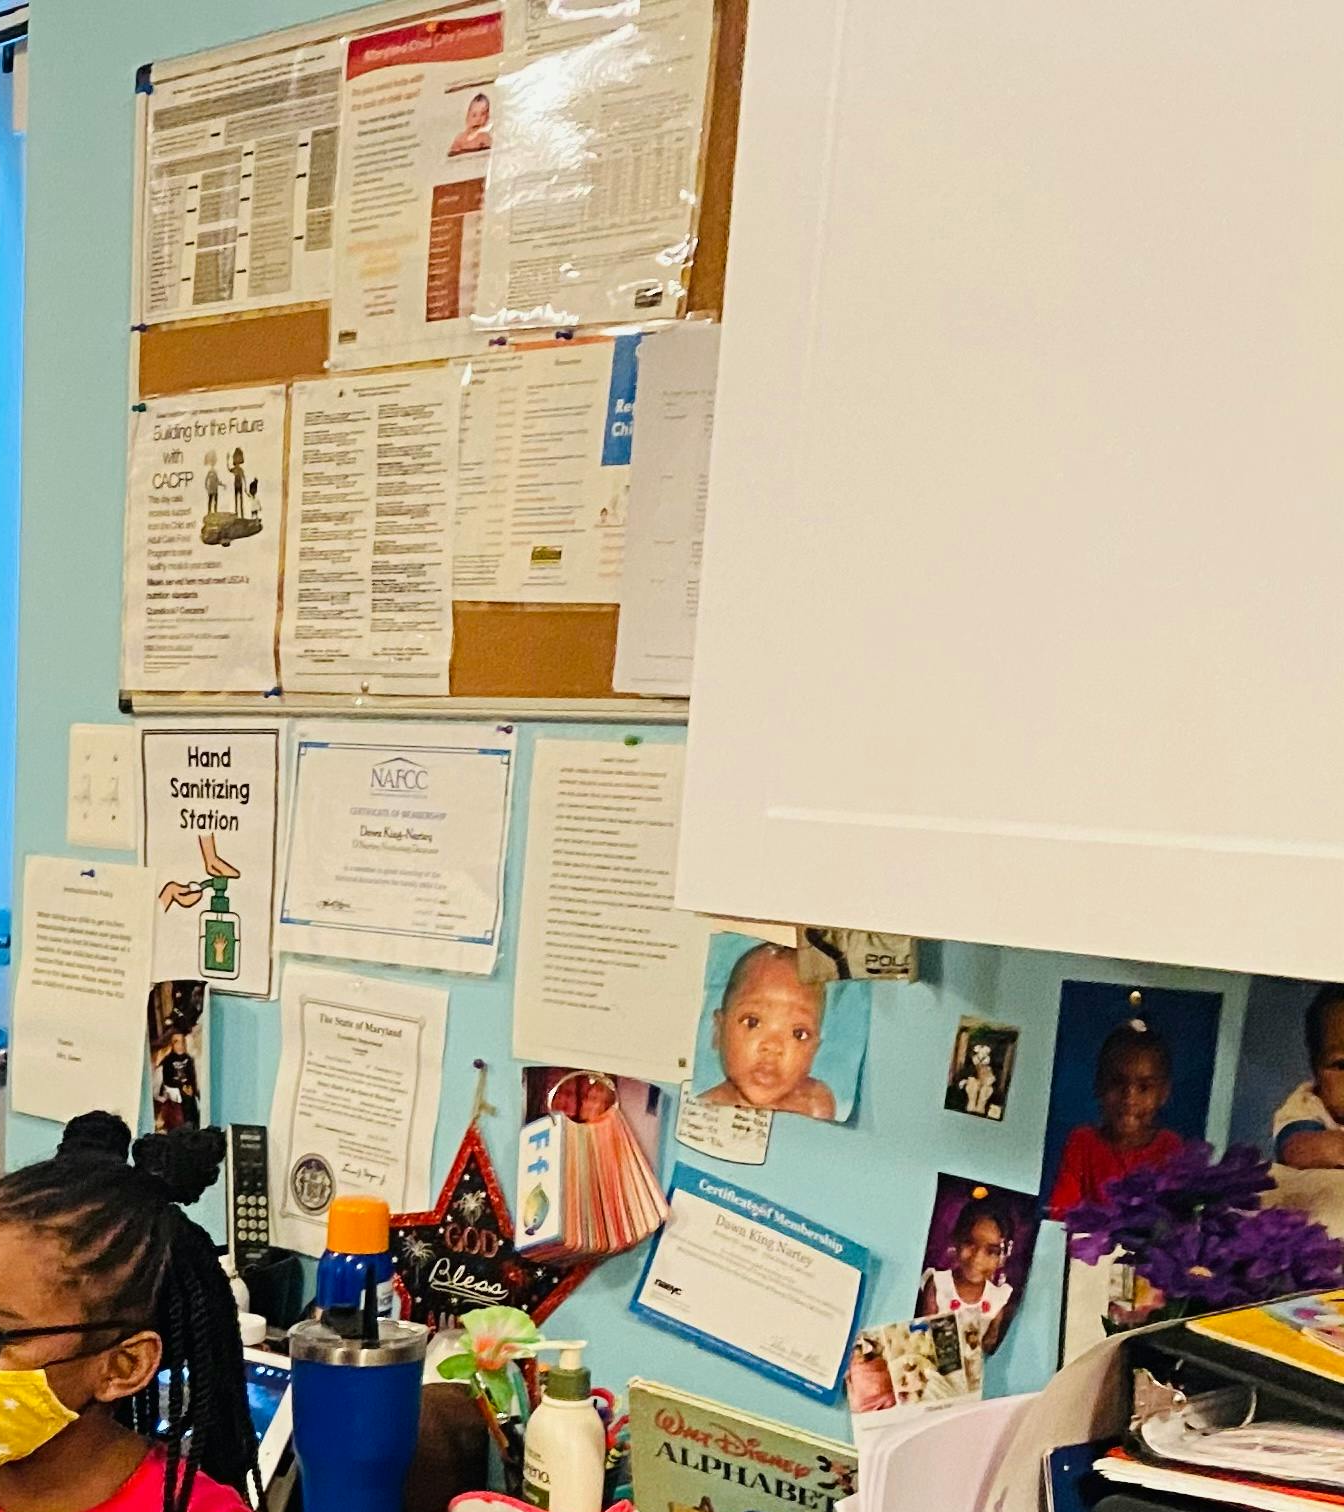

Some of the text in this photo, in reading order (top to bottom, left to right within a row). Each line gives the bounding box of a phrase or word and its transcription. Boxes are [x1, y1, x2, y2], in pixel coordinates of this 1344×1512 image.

[194, 420, 209, 438] for
[228, 416, 264, 434] Future
[188, 746, 231, 768] Hand
[170, 777, 250, 805] Sanitizing
[371, 768, 429, 790] NAFCC
[180, 808, 239, 831] Station
[319, 1012, 402, 1040] The State of Maryland
[445, 1223, 499, 1259] GOD
[715, 1214, 747, 1238] Dawn
[749, 1229, 775, 1250] King
[775, 1209, 844, 1254] Membership
[428, 1257, 509, 1298] Bless
